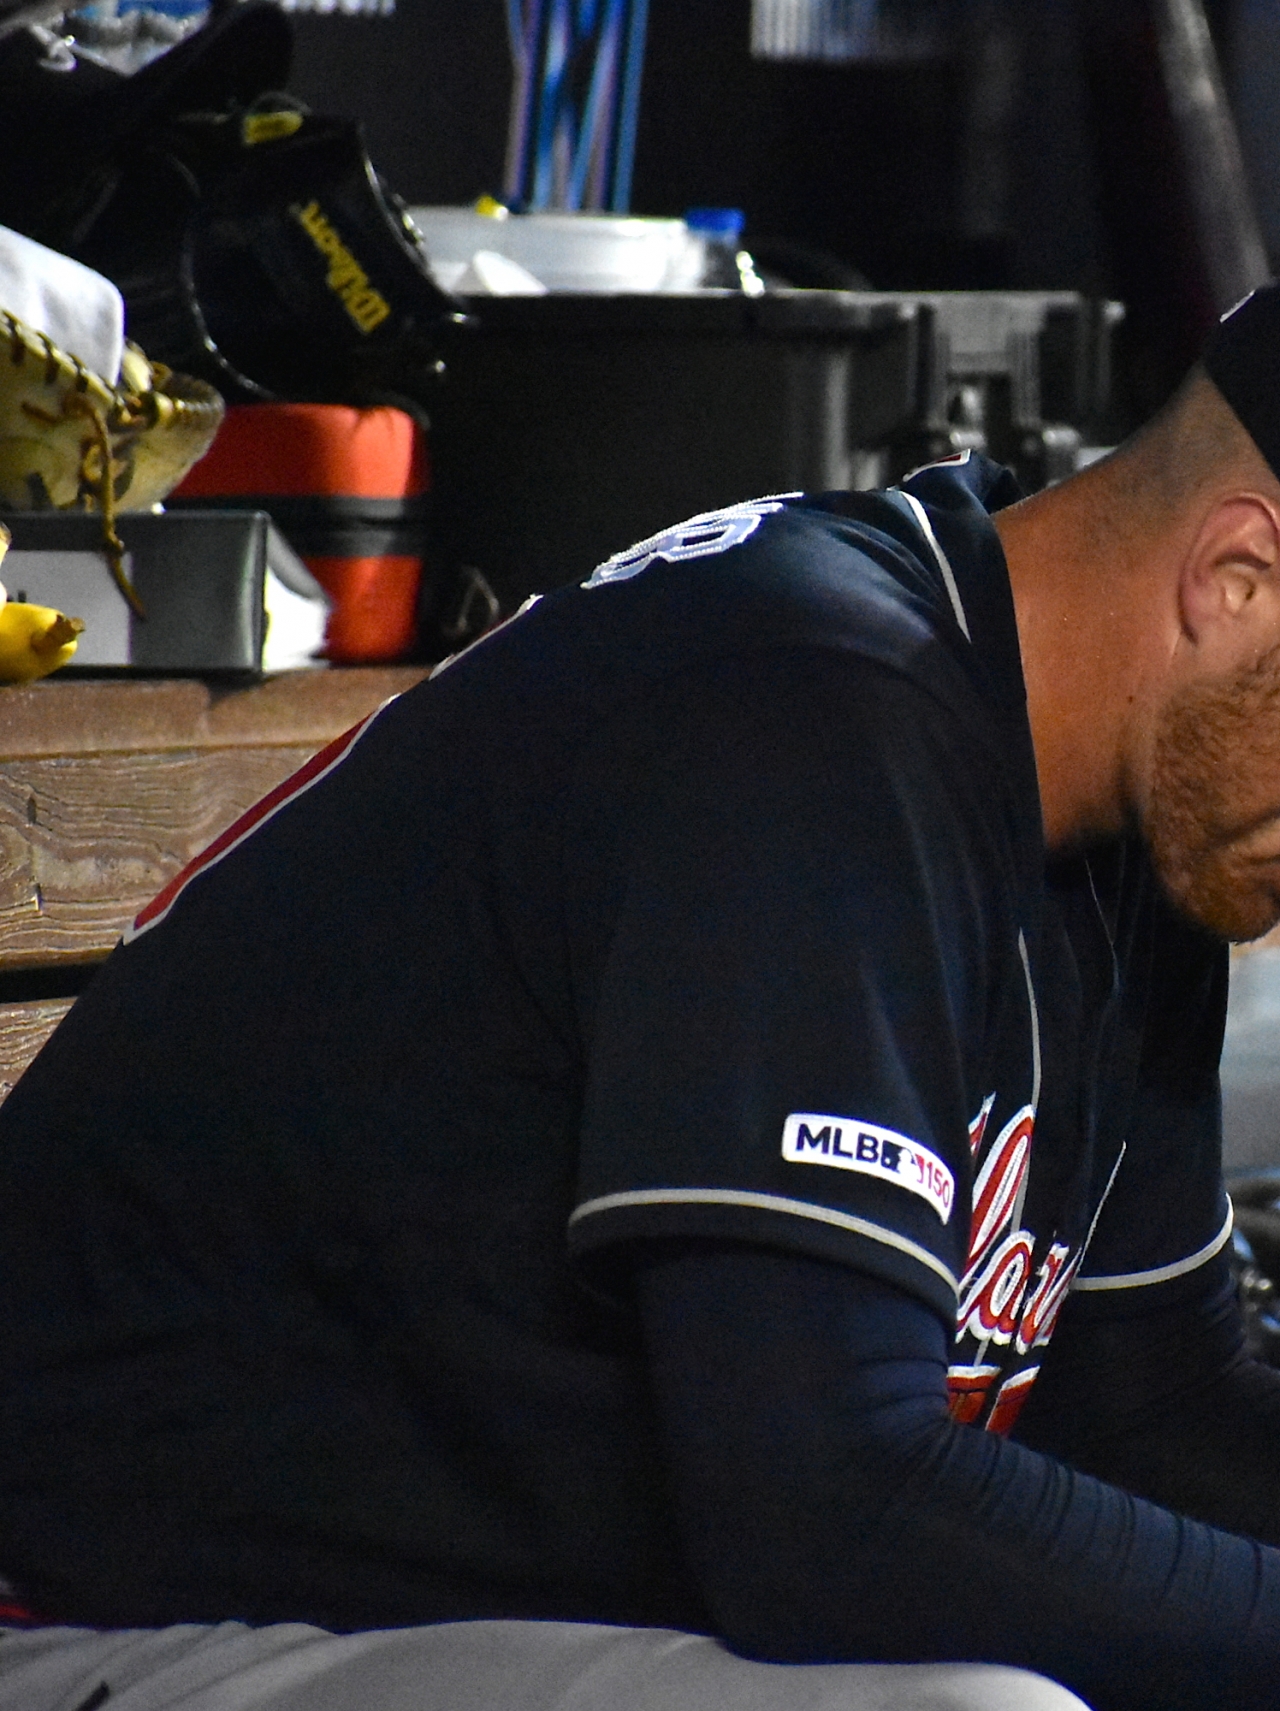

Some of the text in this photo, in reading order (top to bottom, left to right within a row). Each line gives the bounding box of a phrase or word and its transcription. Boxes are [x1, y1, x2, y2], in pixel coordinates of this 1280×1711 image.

[300, 202, 391, 334] Wilson
[795, 1123, 951, 1209] MLB 150
